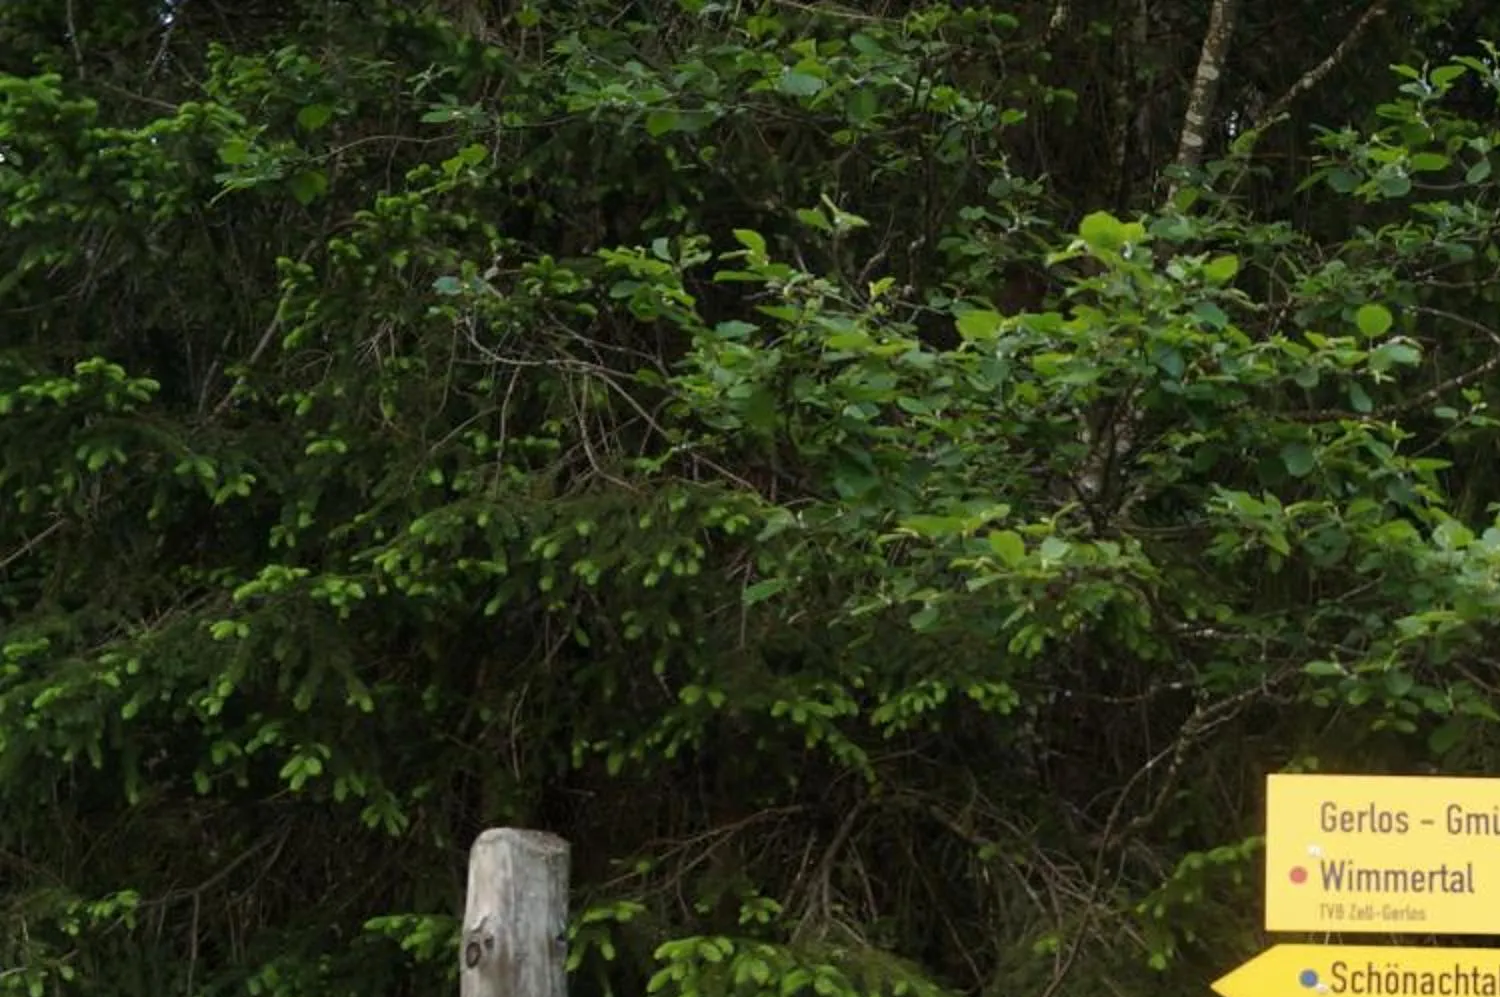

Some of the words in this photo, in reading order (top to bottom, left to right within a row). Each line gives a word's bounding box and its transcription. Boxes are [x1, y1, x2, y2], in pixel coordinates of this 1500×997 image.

[1320, 801, 1409, 833] Gerlos
[1320, 859, 1475, 894] Wimmertal
[1319, 903, 1345, 921] TVB
[1349, 903, 1427, 921] Zell-Gerlos
